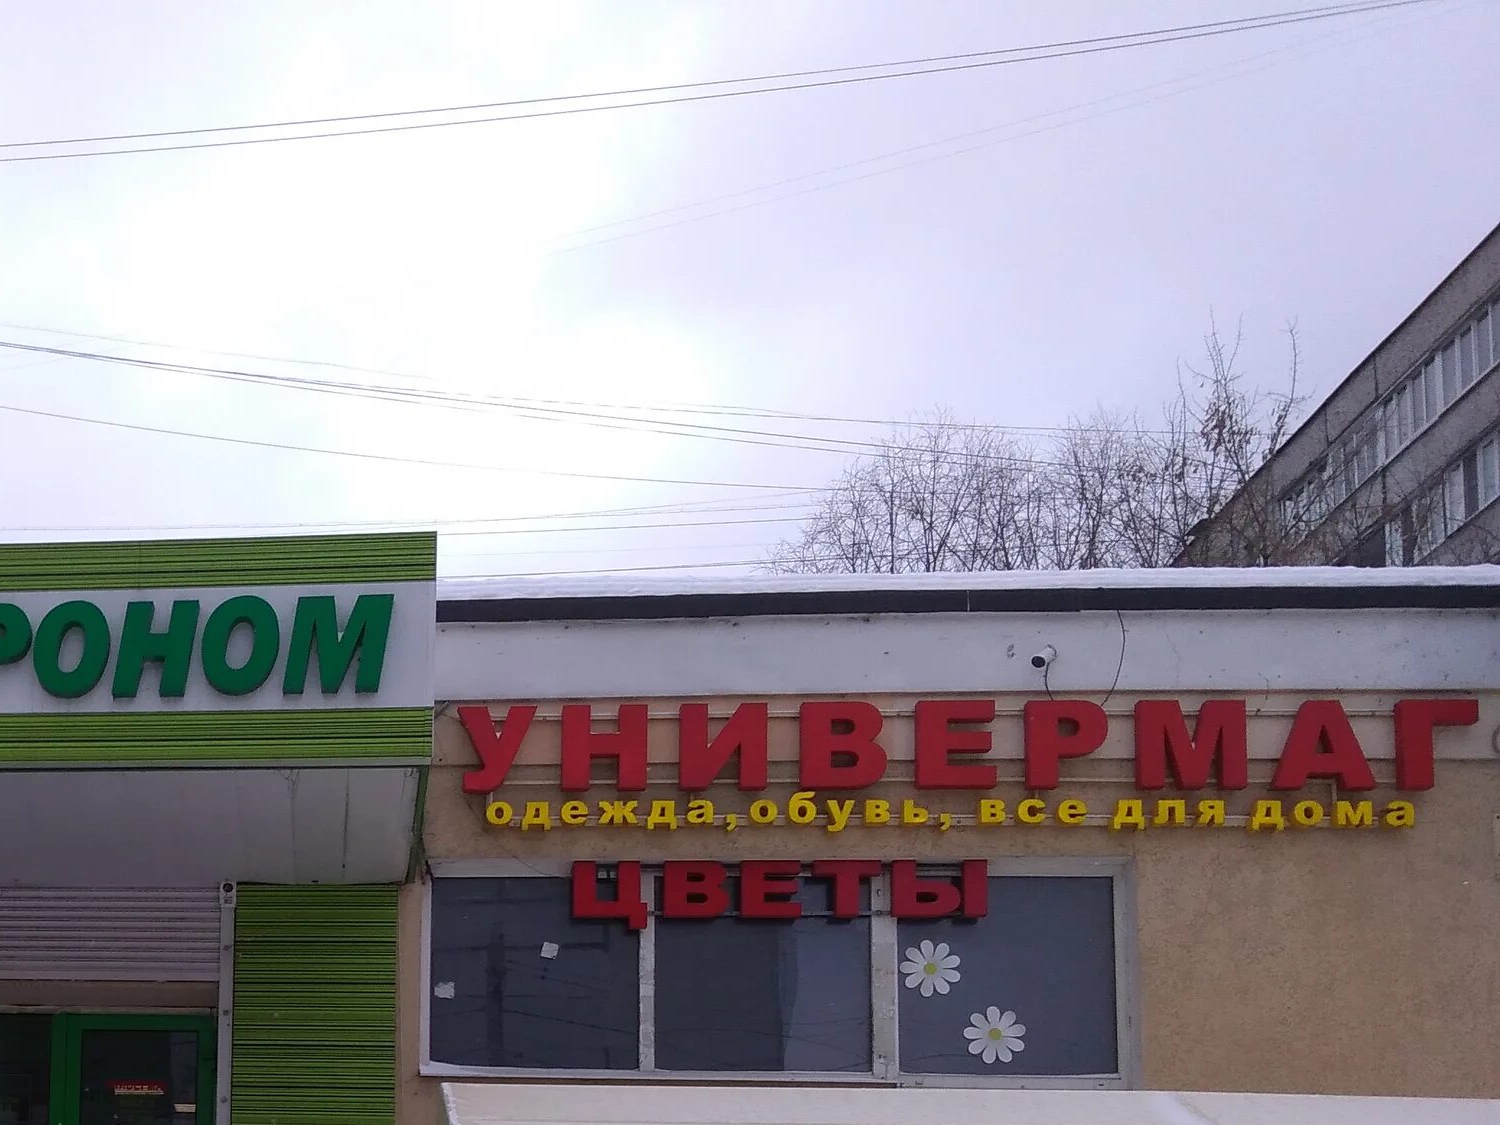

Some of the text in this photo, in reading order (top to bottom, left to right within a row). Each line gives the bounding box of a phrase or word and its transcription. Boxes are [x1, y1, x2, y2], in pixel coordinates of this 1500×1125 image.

[456, 698, 1478, 792] УНИВЕРМАГ
[980, 798, 1088, 826] все
[1113, 798, 1226, 832] для
[1250, 798, 1417, 833] дома
[572, 859, 989, 929] ЦВЕТЫ
